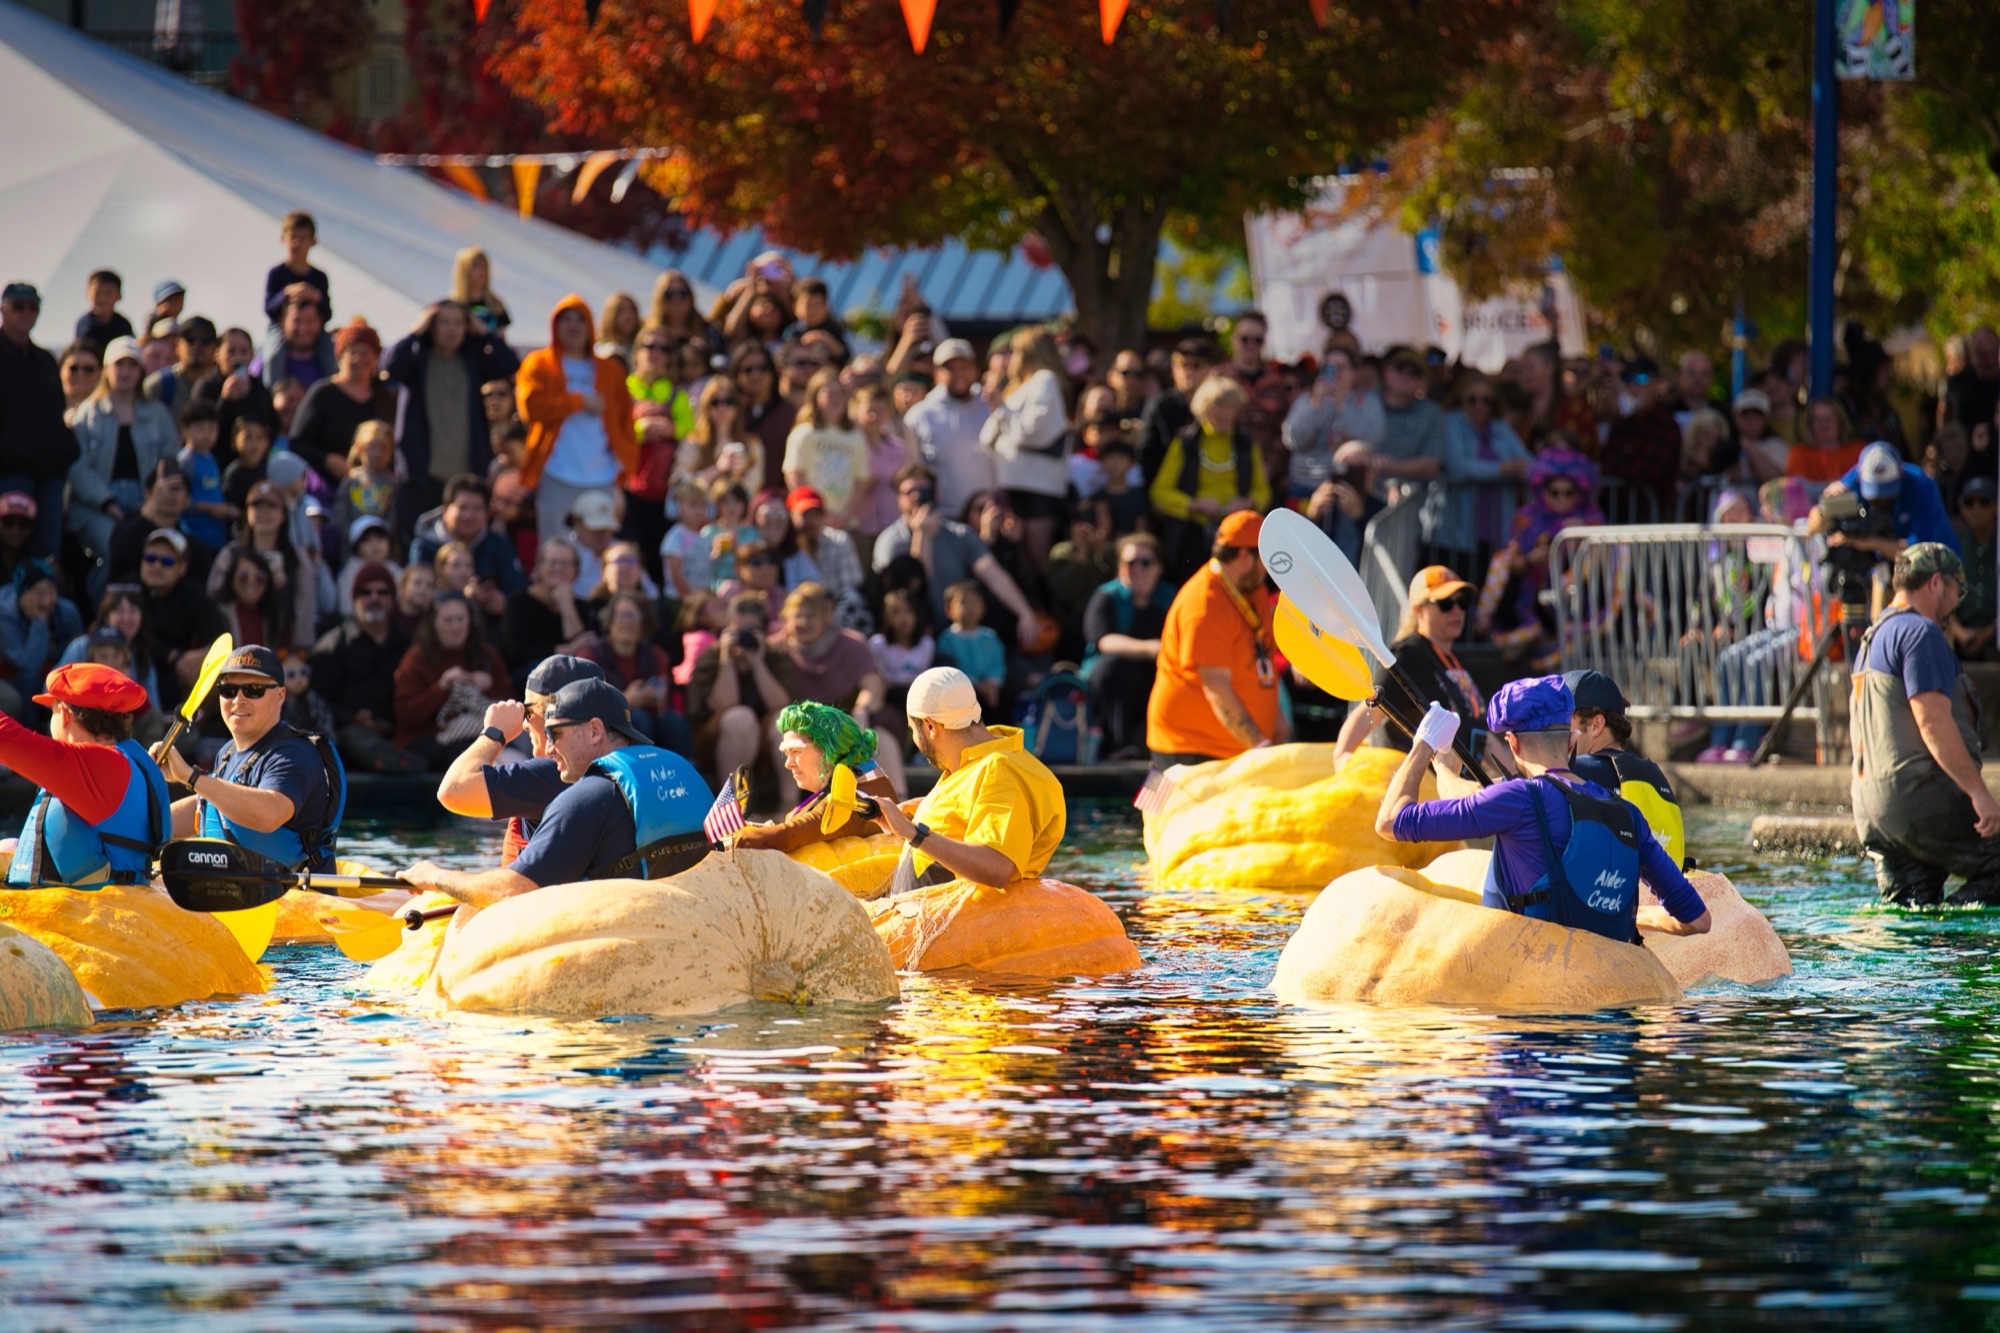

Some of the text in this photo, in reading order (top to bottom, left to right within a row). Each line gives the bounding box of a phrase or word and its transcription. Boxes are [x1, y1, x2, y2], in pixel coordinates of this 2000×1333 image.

[650, 765, 677, 783] Alder
[1620, 830, 1633, 838] NRS
[188, 851, 228, 865] cannon
[1594, 869, 1627, 889] Alder
[1587, 890, 1622, 912] Creek
